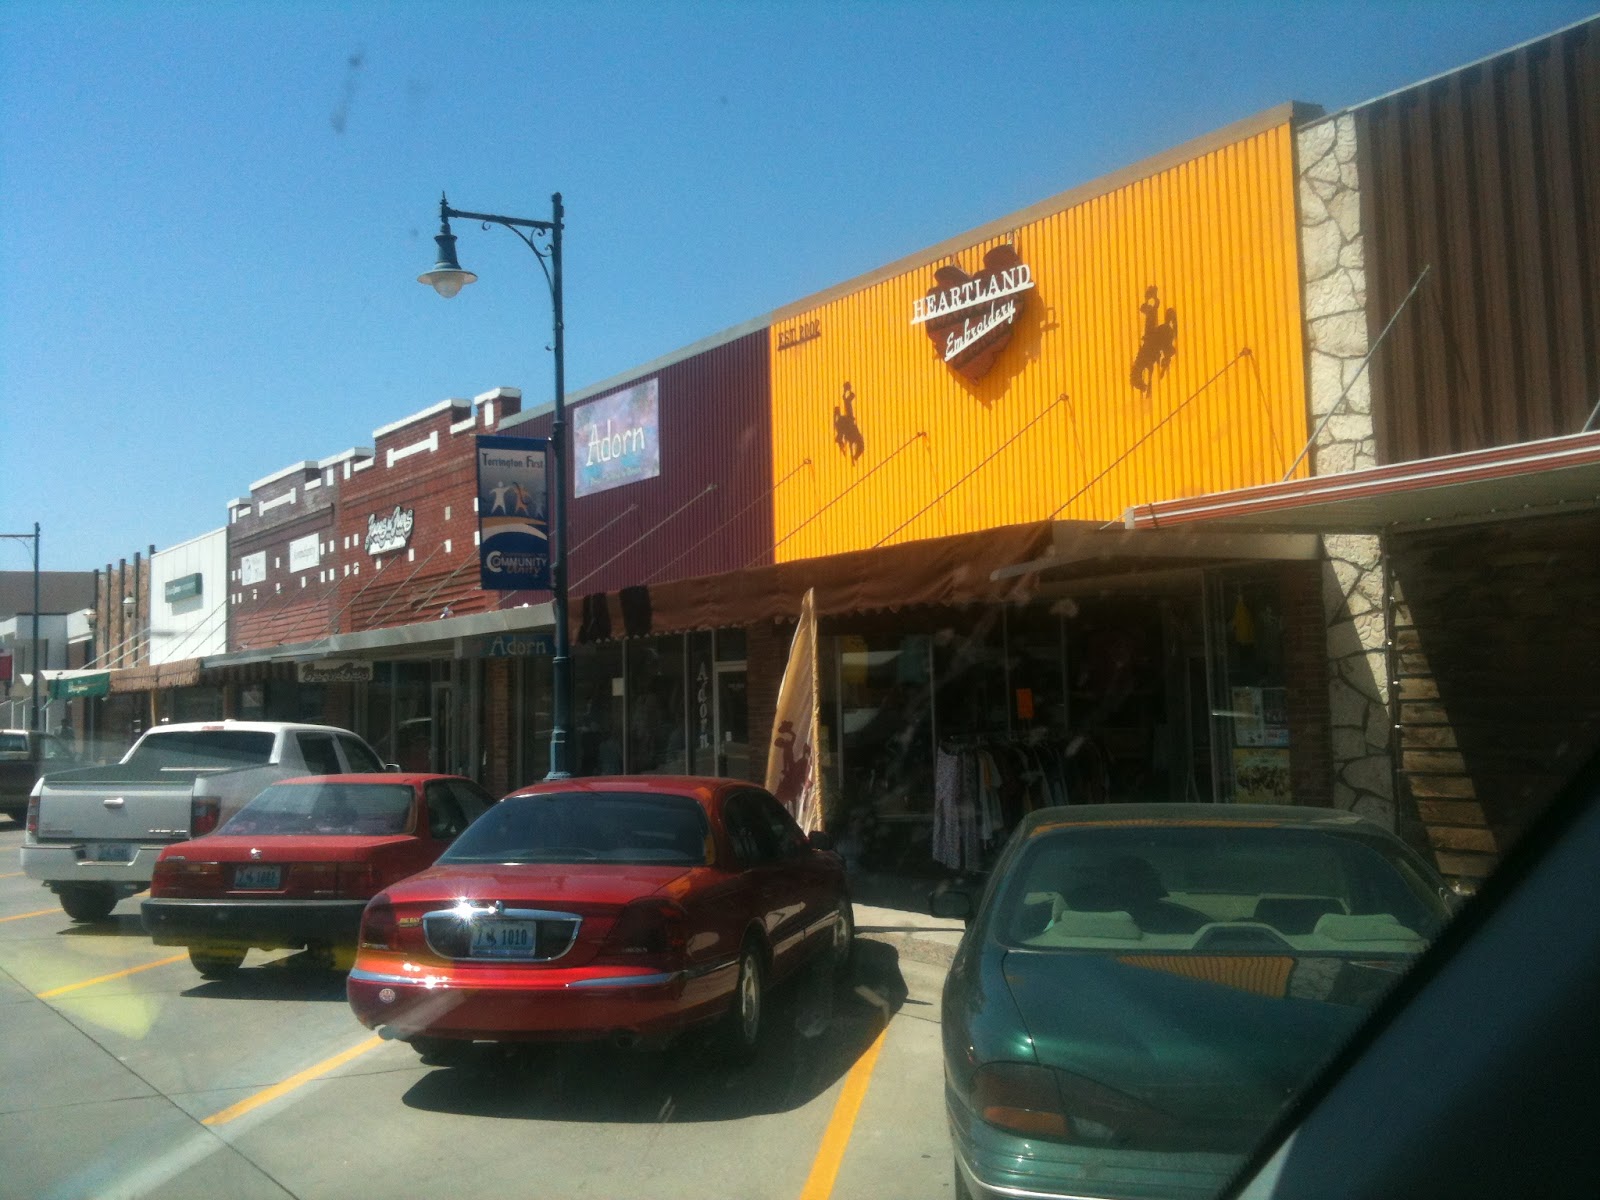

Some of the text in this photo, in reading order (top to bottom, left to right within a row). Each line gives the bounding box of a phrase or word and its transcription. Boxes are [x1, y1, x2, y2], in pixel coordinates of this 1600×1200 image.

[912, 264, 1032, 322] HEARTLAND
[945, 297, 1016, 358] Embroidery
[482, 453, 544, 468] Torrington First
[586, 419, 646, 467] Adorn
[486, 550, 547, 572] COMMUNITY
[489, 633, 547, 657] Adorn
[696, 661, 709, 749] Adorn
[502, 928, 527, 945] 1010
